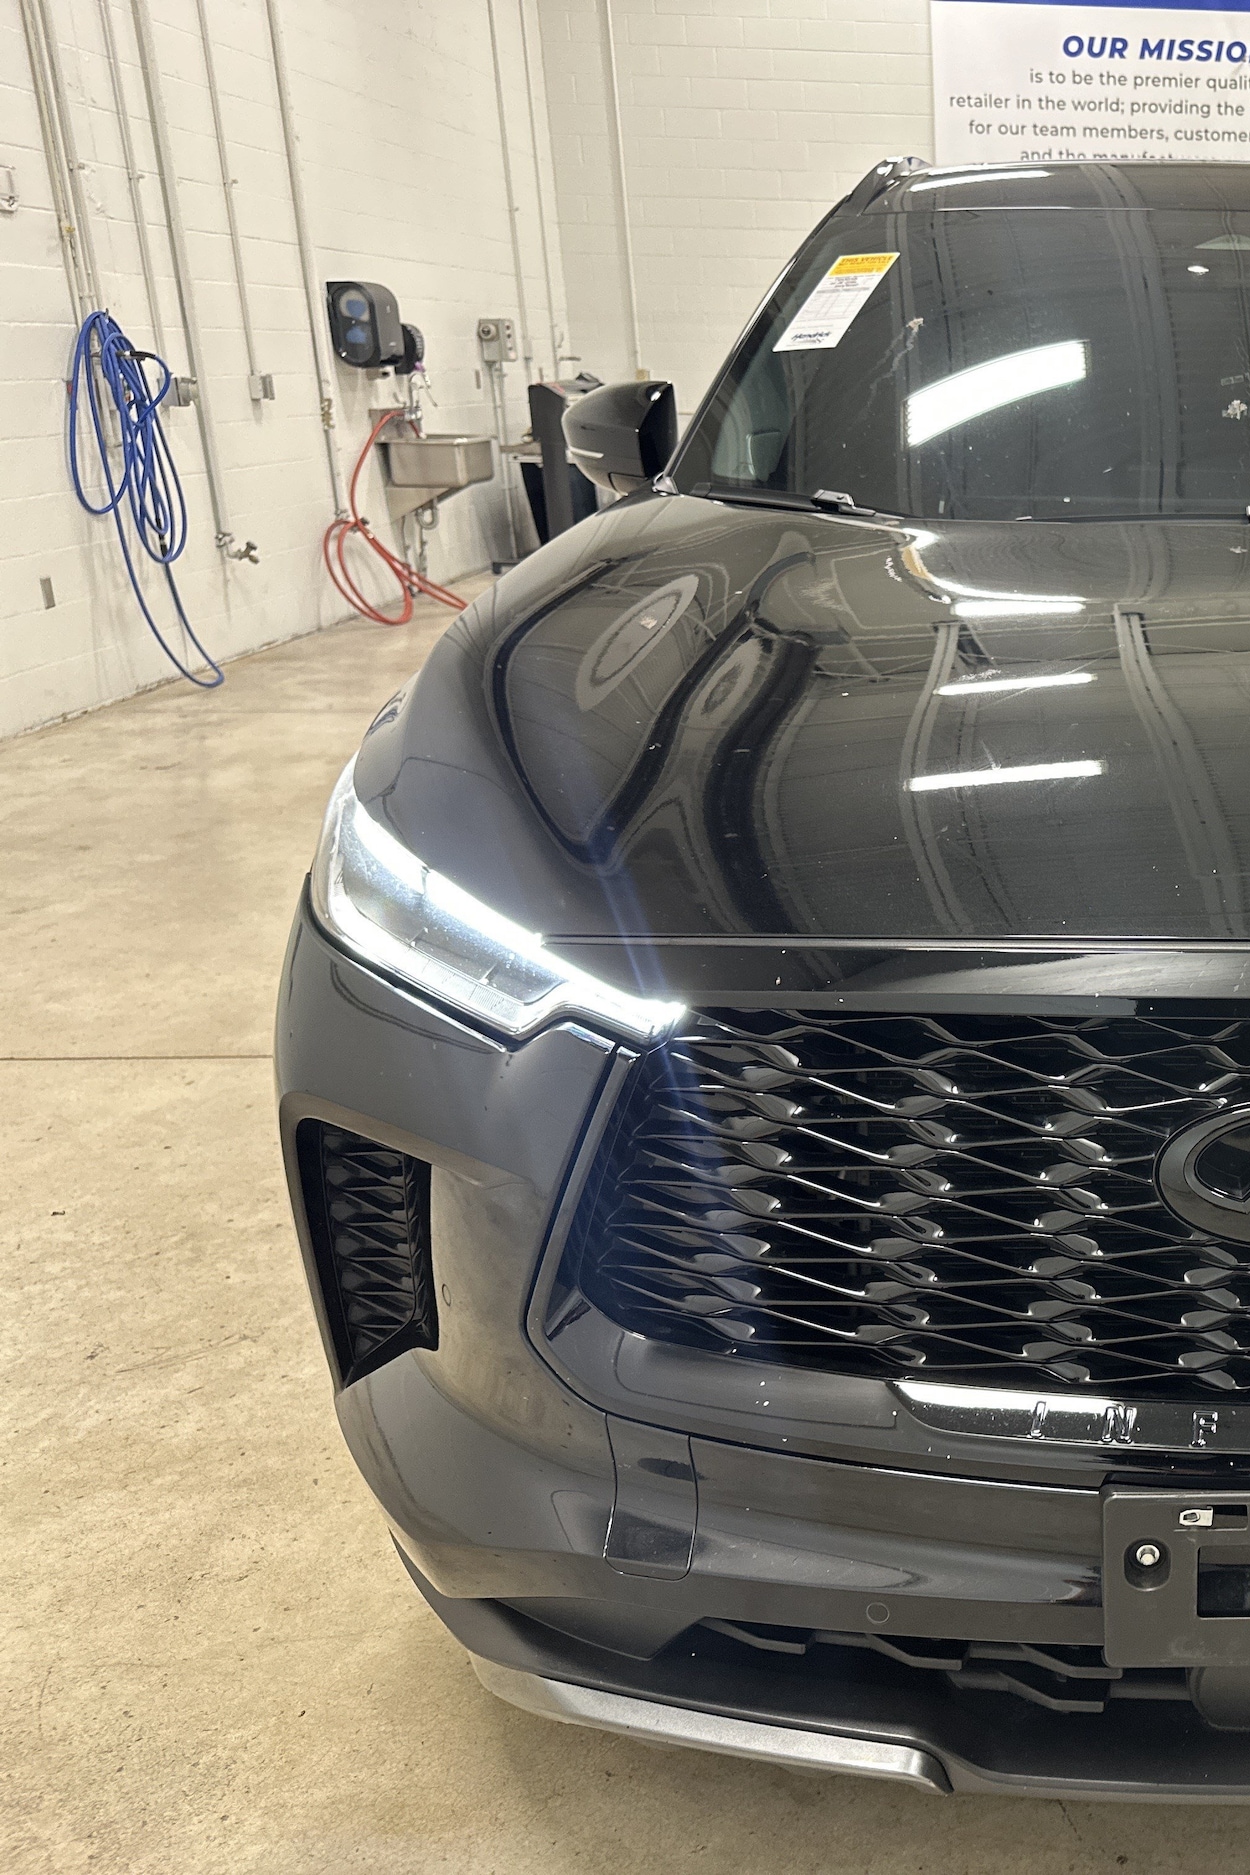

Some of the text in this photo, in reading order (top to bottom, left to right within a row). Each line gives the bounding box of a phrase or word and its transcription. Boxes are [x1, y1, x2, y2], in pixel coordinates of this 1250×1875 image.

[1062, 35, 1129, 60] OUR
[1029, 68, 1044, 84] is
[1048, 70, 1066, 85] to
[1072, 70, 1094, 86] be
[1098, 71, 1128, 87] the
[1133, 73, 1202, 92] premier
[949, 93, 1011, 109] retailer
[1016, 94, 1032, 110] in
[1037, 95, 1067, 112] the
[1071, 97, 1125, 115] world;
[1130, 98, 1211, 119] providing
[1216, 101, 1245, 117] the
[968, 119, 992, 135] for
[997, 123, 1027, 136] our
[1032, 122, 1077, 138] team
[1082, 124, 1169, 143] members,
[1020, 149, 1053, 161] and
